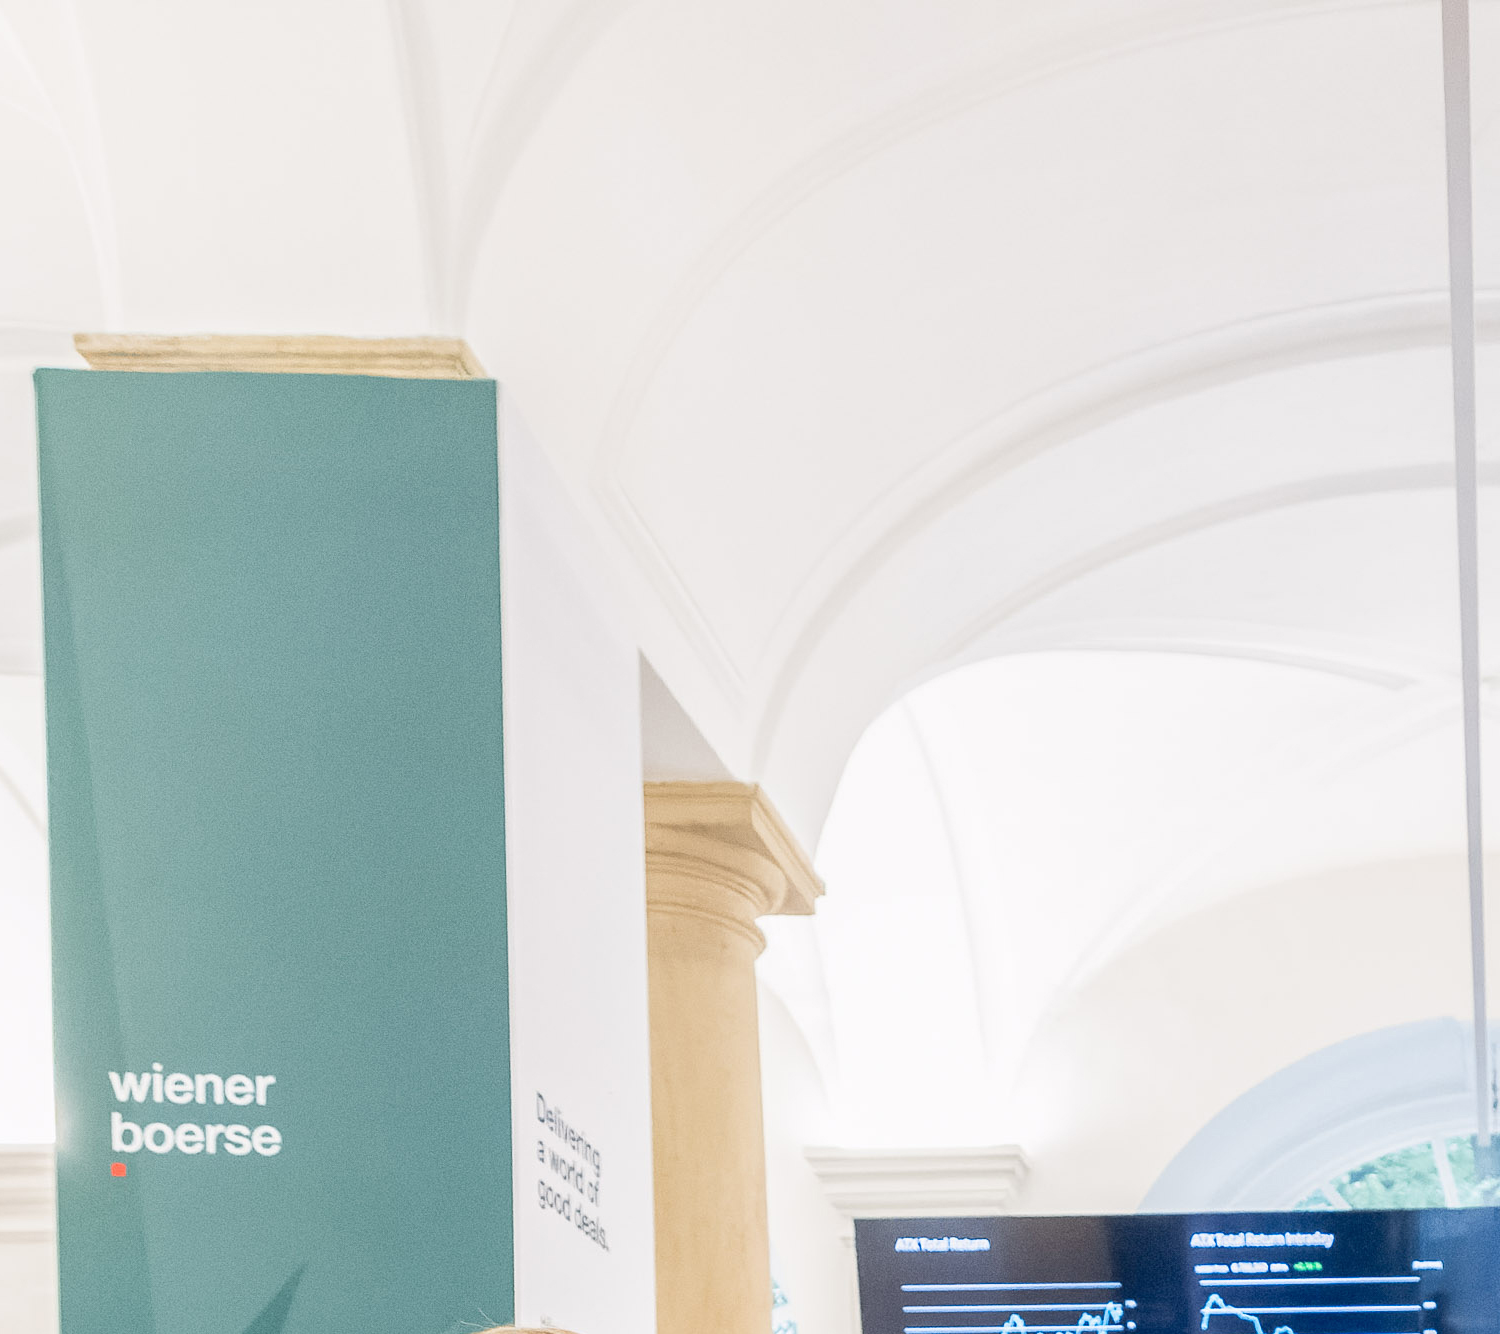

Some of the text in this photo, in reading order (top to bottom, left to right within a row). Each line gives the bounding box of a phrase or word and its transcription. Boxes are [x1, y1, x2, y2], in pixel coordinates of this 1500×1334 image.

[108, 1062, 276, 1106] wiener
[110, 1111, 283, 1157] boerse
[536, 1091, 601, 1178] Delivering
[537, 1140, 599, 1208] a world of
[538, 1179, 610, 1252] good deals.
